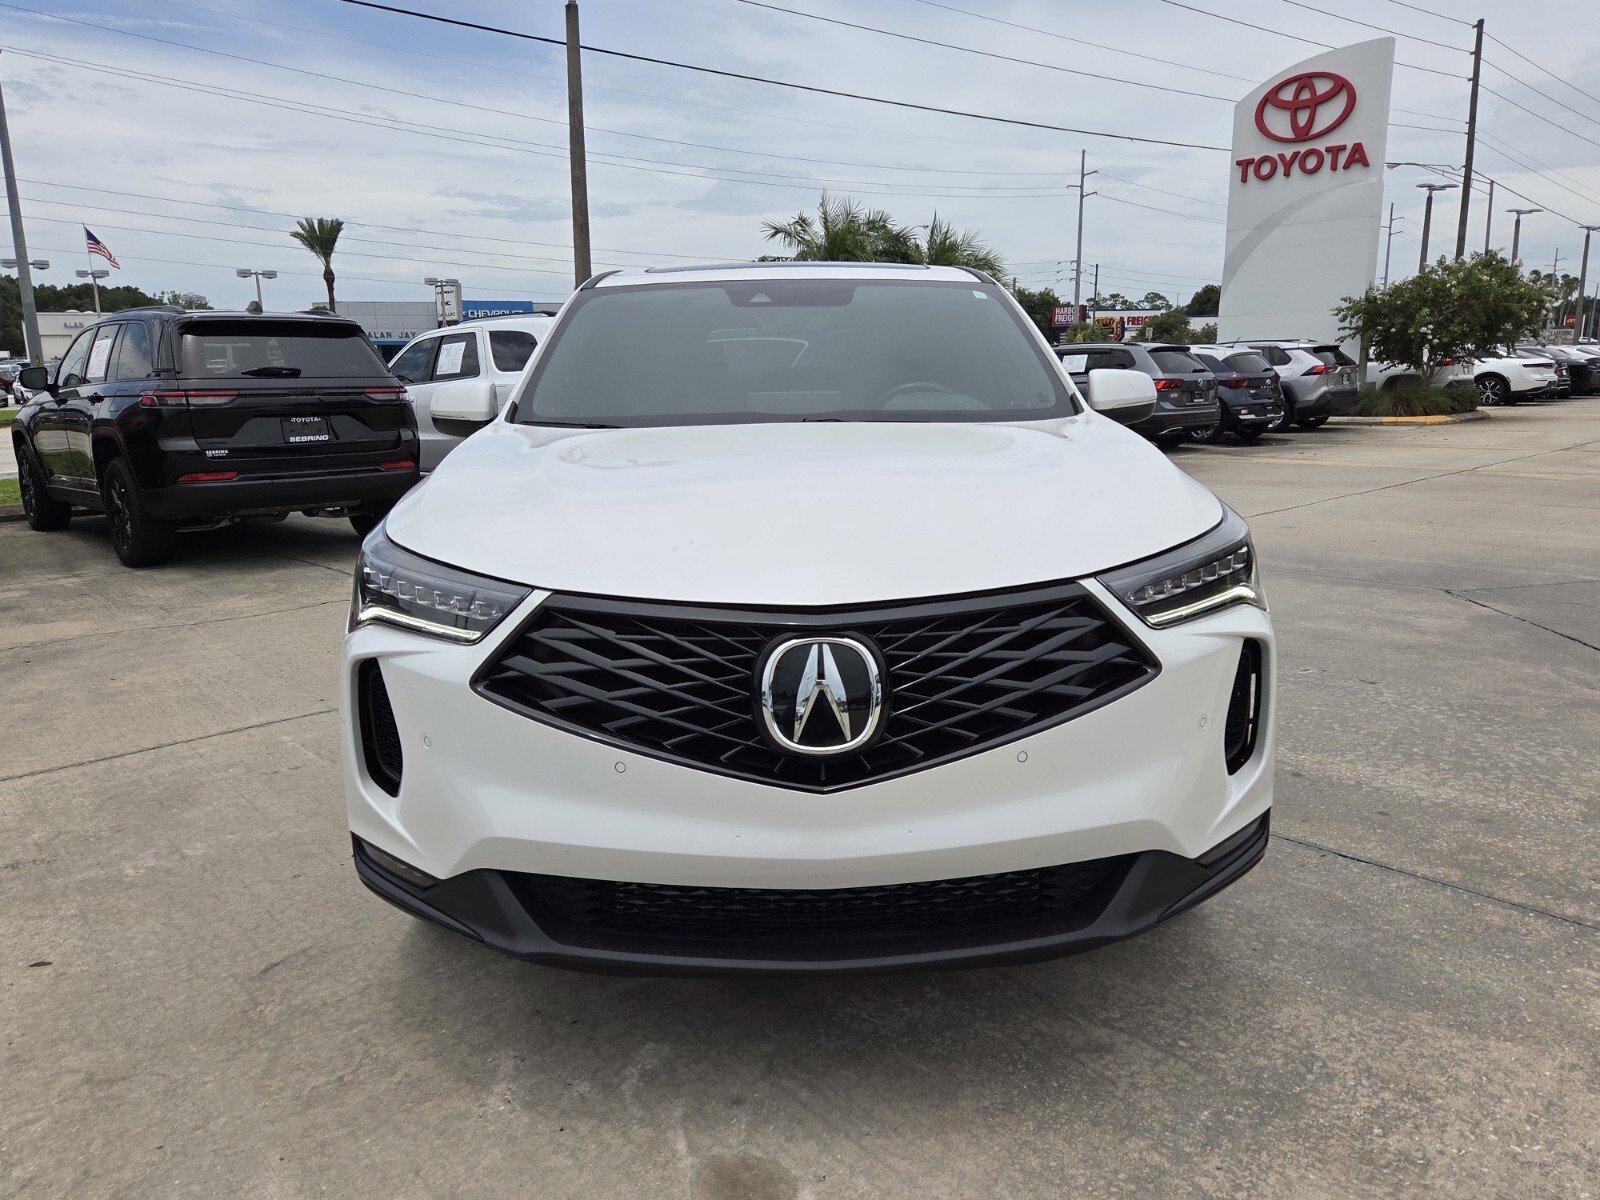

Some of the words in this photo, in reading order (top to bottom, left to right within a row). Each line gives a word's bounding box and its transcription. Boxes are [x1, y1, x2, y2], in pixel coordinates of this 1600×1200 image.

[1236, 142, 1370, 184] TOYOTA
[1055, 306, 1075, 315] HARBO
[1055, 314, 1075, 322] FREIGH
[63, 321, 84, 329] ALAN
[367, 331, 392, 339] ALAN
[398, 331, 416, 339] JAY
[289, 434, 329, 442] SEBRING
